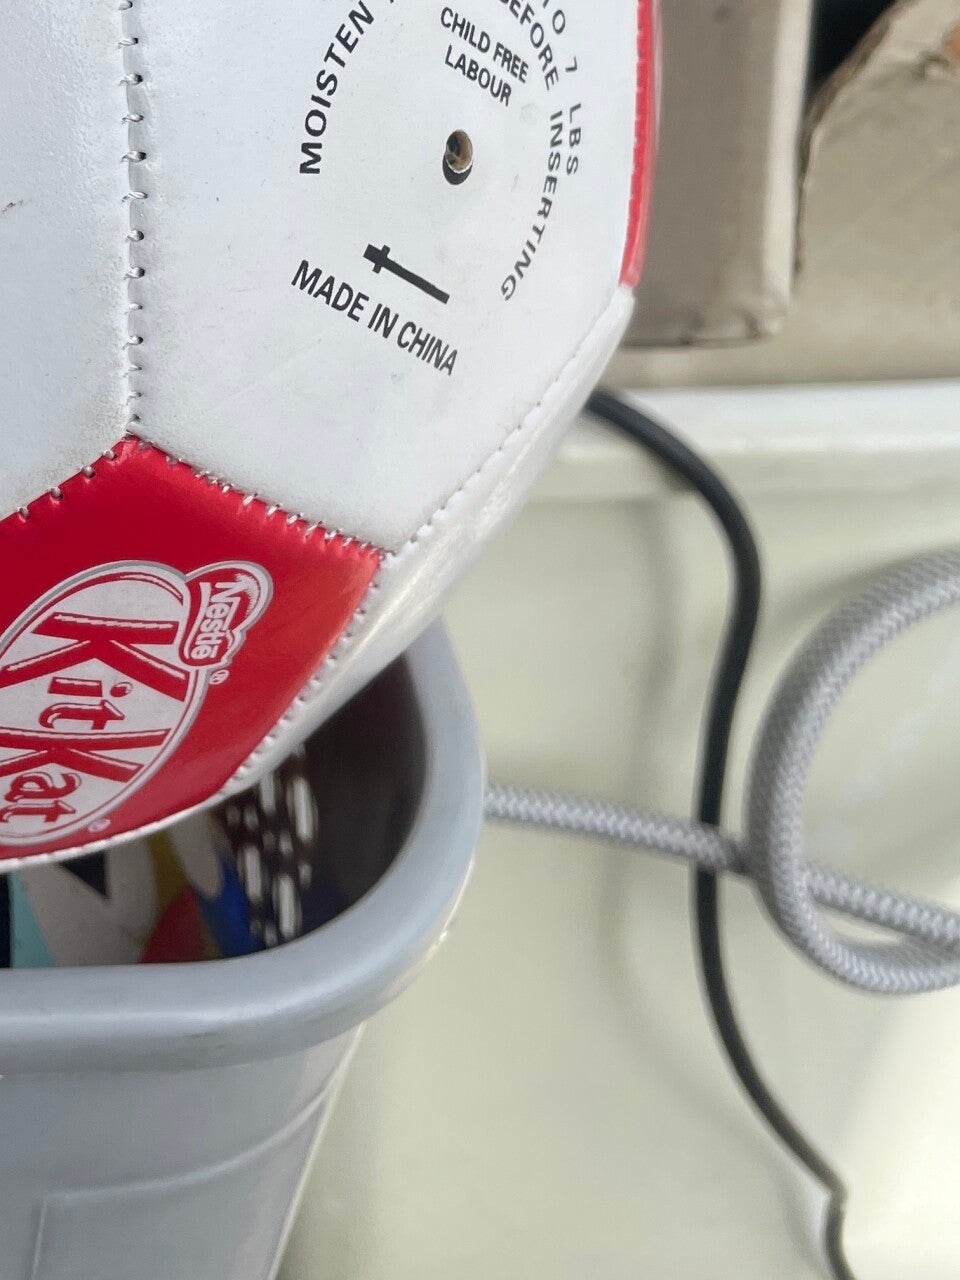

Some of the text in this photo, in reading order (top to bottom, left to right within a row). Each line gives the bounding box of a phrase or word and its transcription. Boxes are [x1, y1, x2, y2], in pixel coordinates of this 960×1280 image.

[440, 6, 530, 85] CHILD FREE
[444, 43, 512, 108] LABOUR
[298, 0, 375, 175] MOISTEN
[500, 109, 564, 302] INSERTING
[565, 102, 582, 176] LBS
[290, 259, 458, 377] MADE IN CHINA
